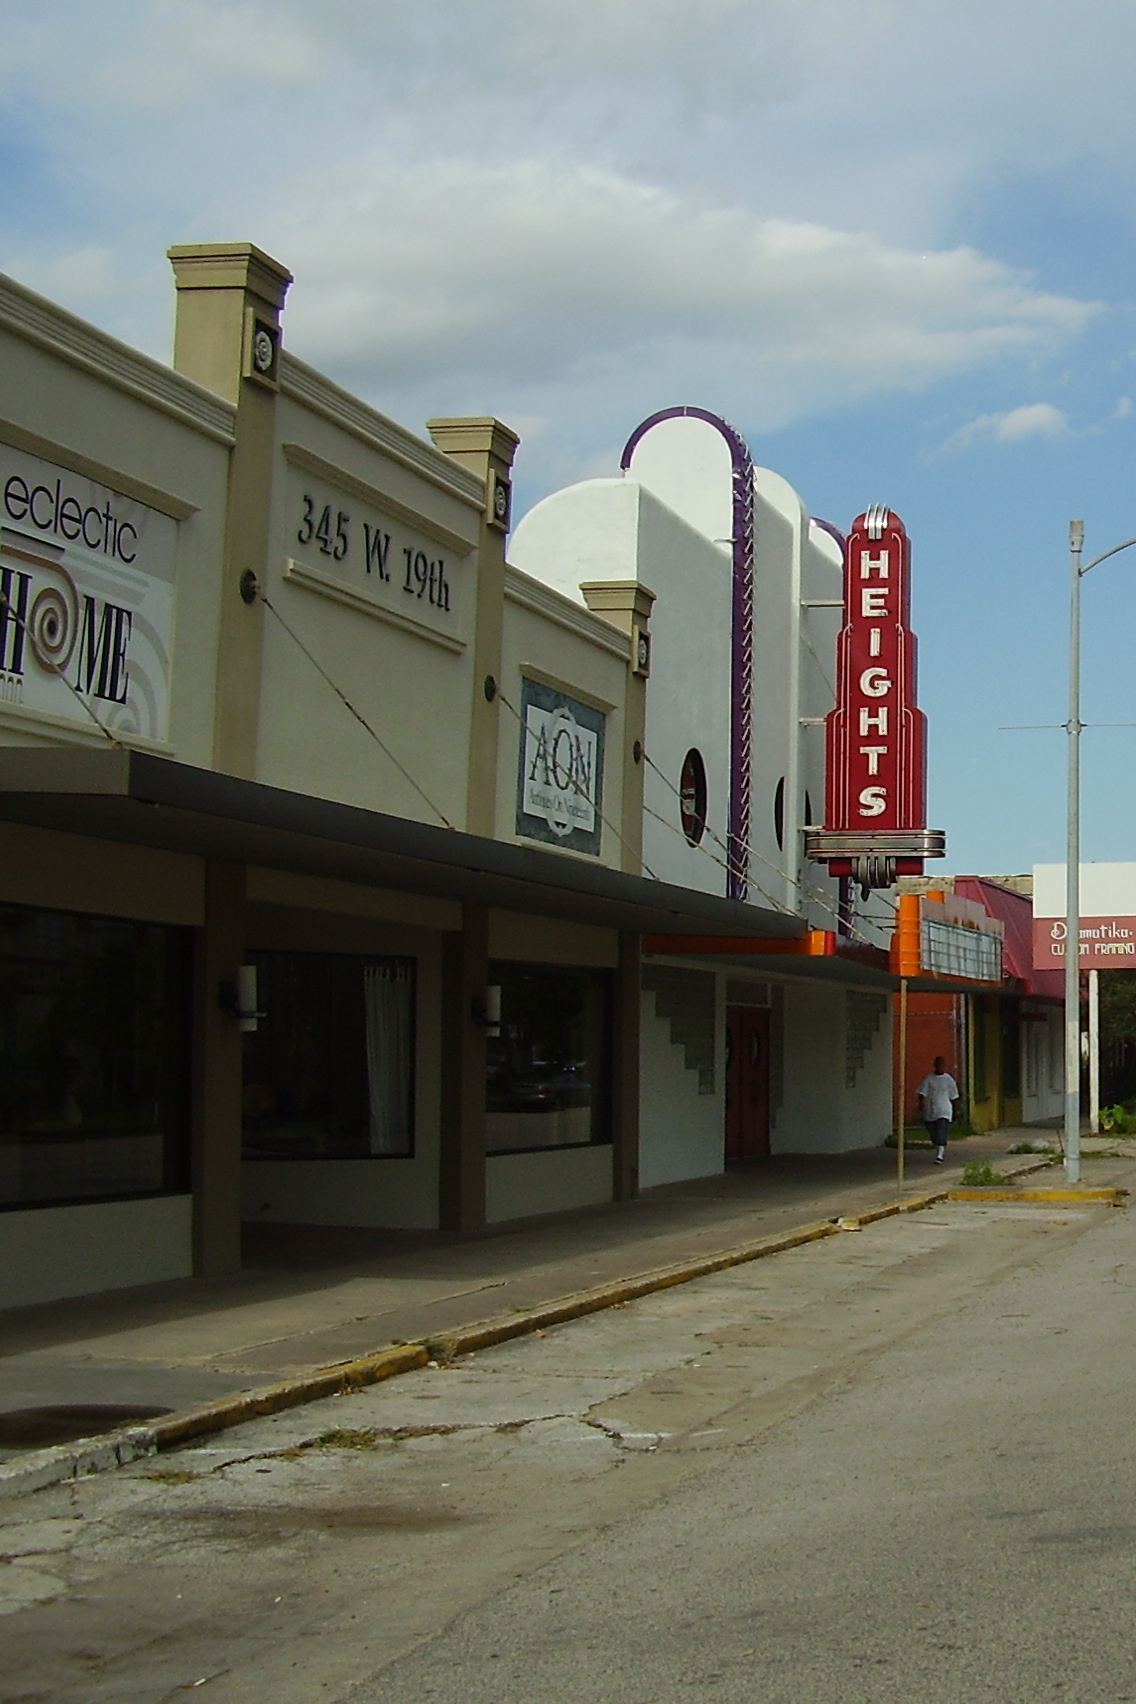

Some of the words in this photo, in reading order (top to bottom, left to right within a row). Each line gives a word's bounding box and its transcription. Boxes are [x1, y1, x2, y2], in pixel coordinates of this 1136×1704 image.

[4, 475, 139, 564] eclectic
[297, 494, 351, 561] 345
[363, 522, 391, 583] W.
[402, 547, 451, 613] 19th
[858, 549, 893, 818] HEIGHTS
